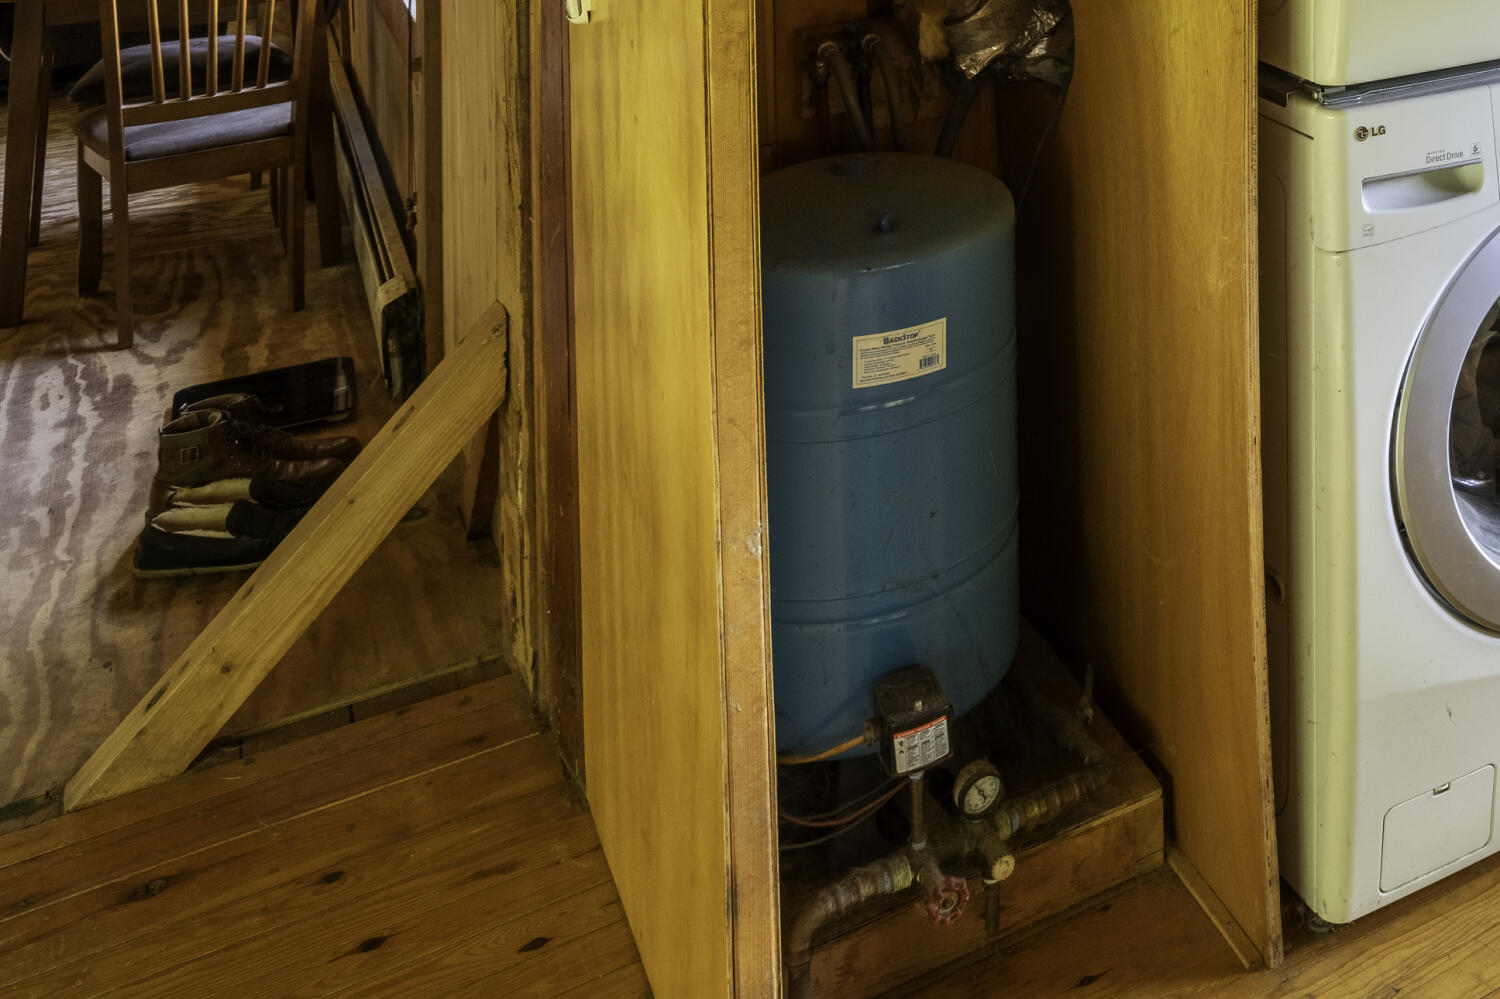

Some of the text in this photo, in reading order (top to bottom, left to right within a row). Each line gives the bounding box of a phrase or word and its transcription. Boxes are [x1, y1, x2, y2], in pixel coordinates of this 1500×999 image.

[1370, 125, 1386, 137] LG
[1425, 150, 1464, 164] Direct Drive
